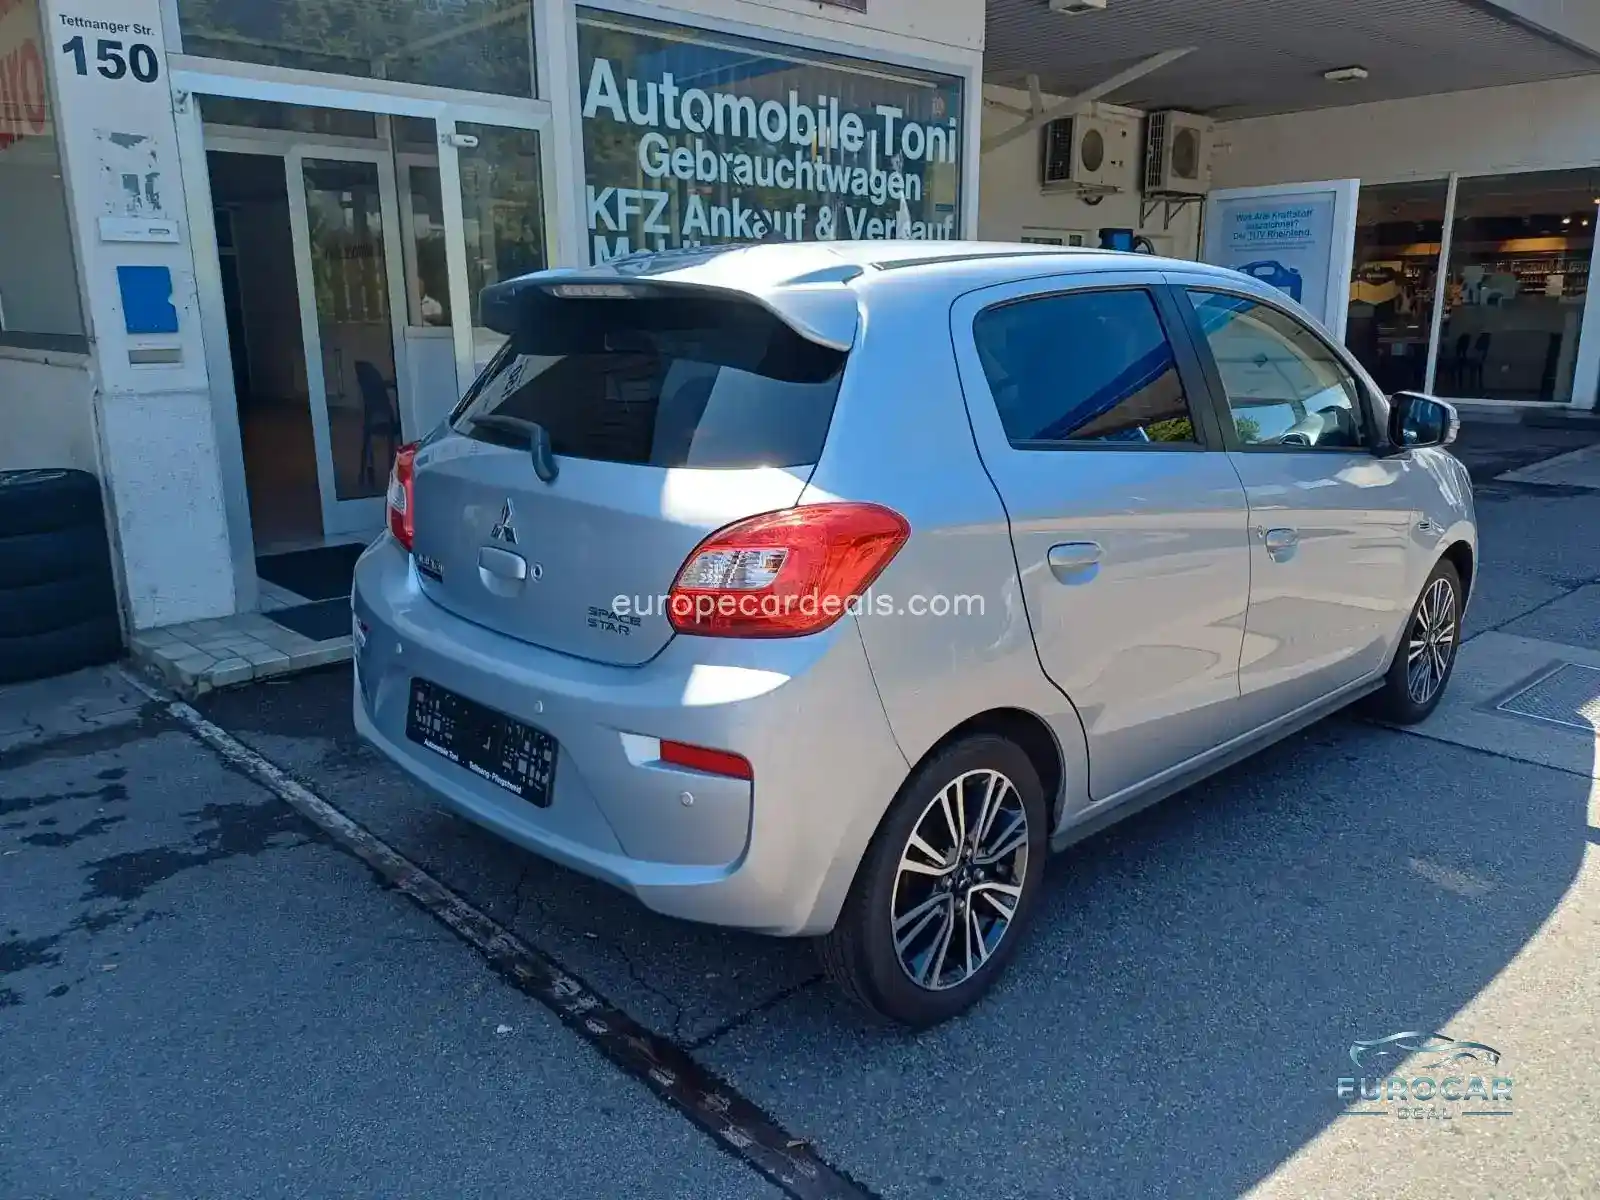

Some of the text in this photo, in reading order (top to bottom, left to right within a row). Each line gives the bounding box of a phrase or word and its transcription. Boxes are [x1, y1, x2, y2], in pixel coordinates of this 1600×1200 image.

[59, 14, 155, 36] Tettnanger Str.
[62, 35, 158, 83] 150
[582, 57, 957, 163] Automobile Toni
[638, 132, 921, 205] Gebrauchtwagen
[586, 185, 670, 234] KFZ
[682, 194, 805, 240] Ankauf
[815, 206, 834, 240] &
[587, 618, 630, 635] STAR
[588, 606, 641, 626] SPACE
